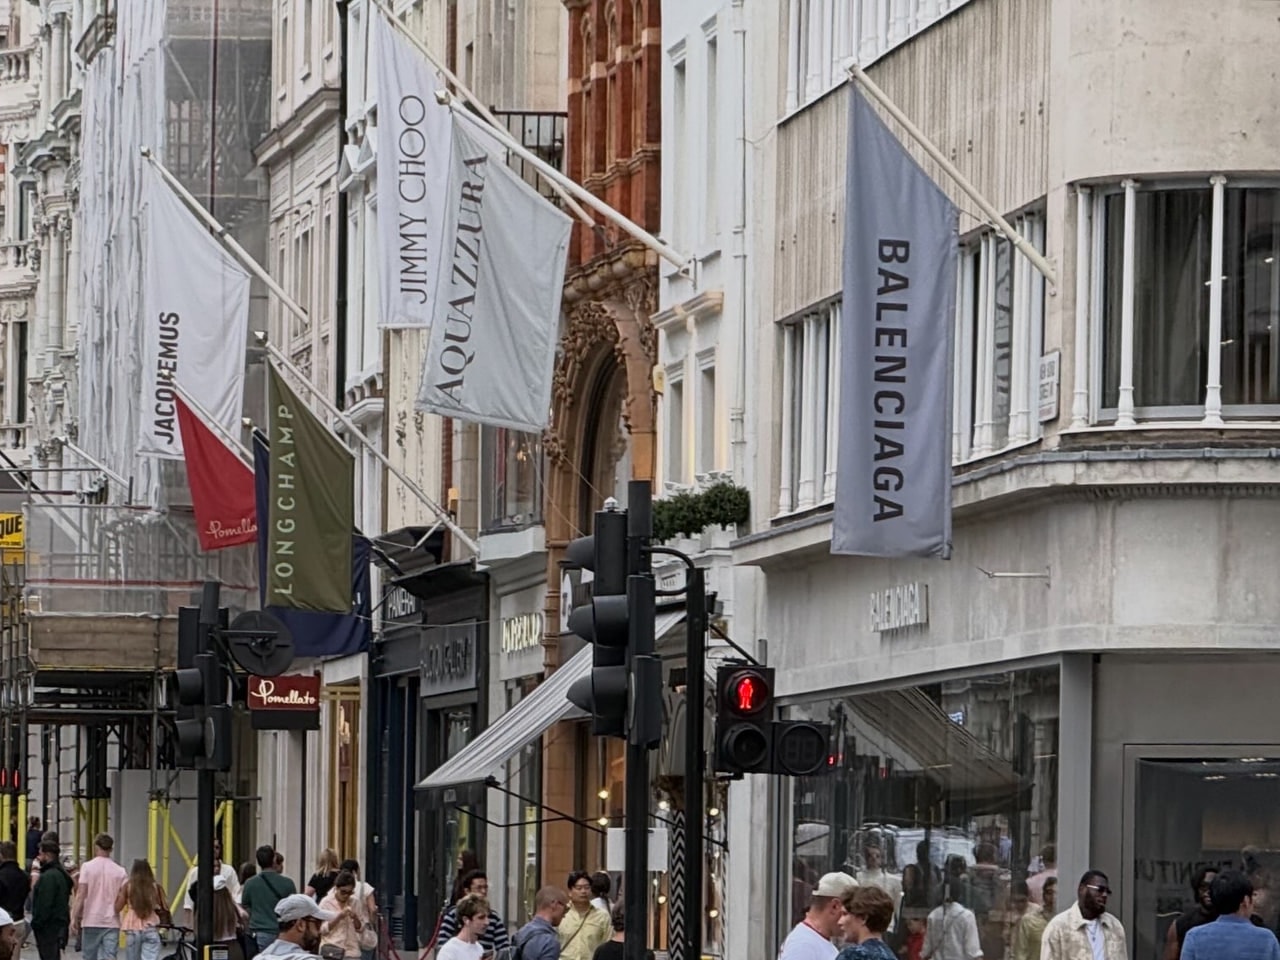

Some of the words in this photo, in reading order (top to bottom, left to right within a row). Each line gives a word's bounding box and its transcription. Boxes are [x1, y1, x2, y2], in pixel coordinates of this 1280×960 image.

[398, 95, 427, 203] CHOO
[399, 213, 428, 304] JIMMY
[434, 152, 488, 406] AQUAZZURA
[154, 311, 180, 445] JACQUEMUS
[873, 238, 911, 523] BALENCIAGA
[274, 404, 295, 595] LONGCHAMP
[251, 679, 316, 706] Pomellato
